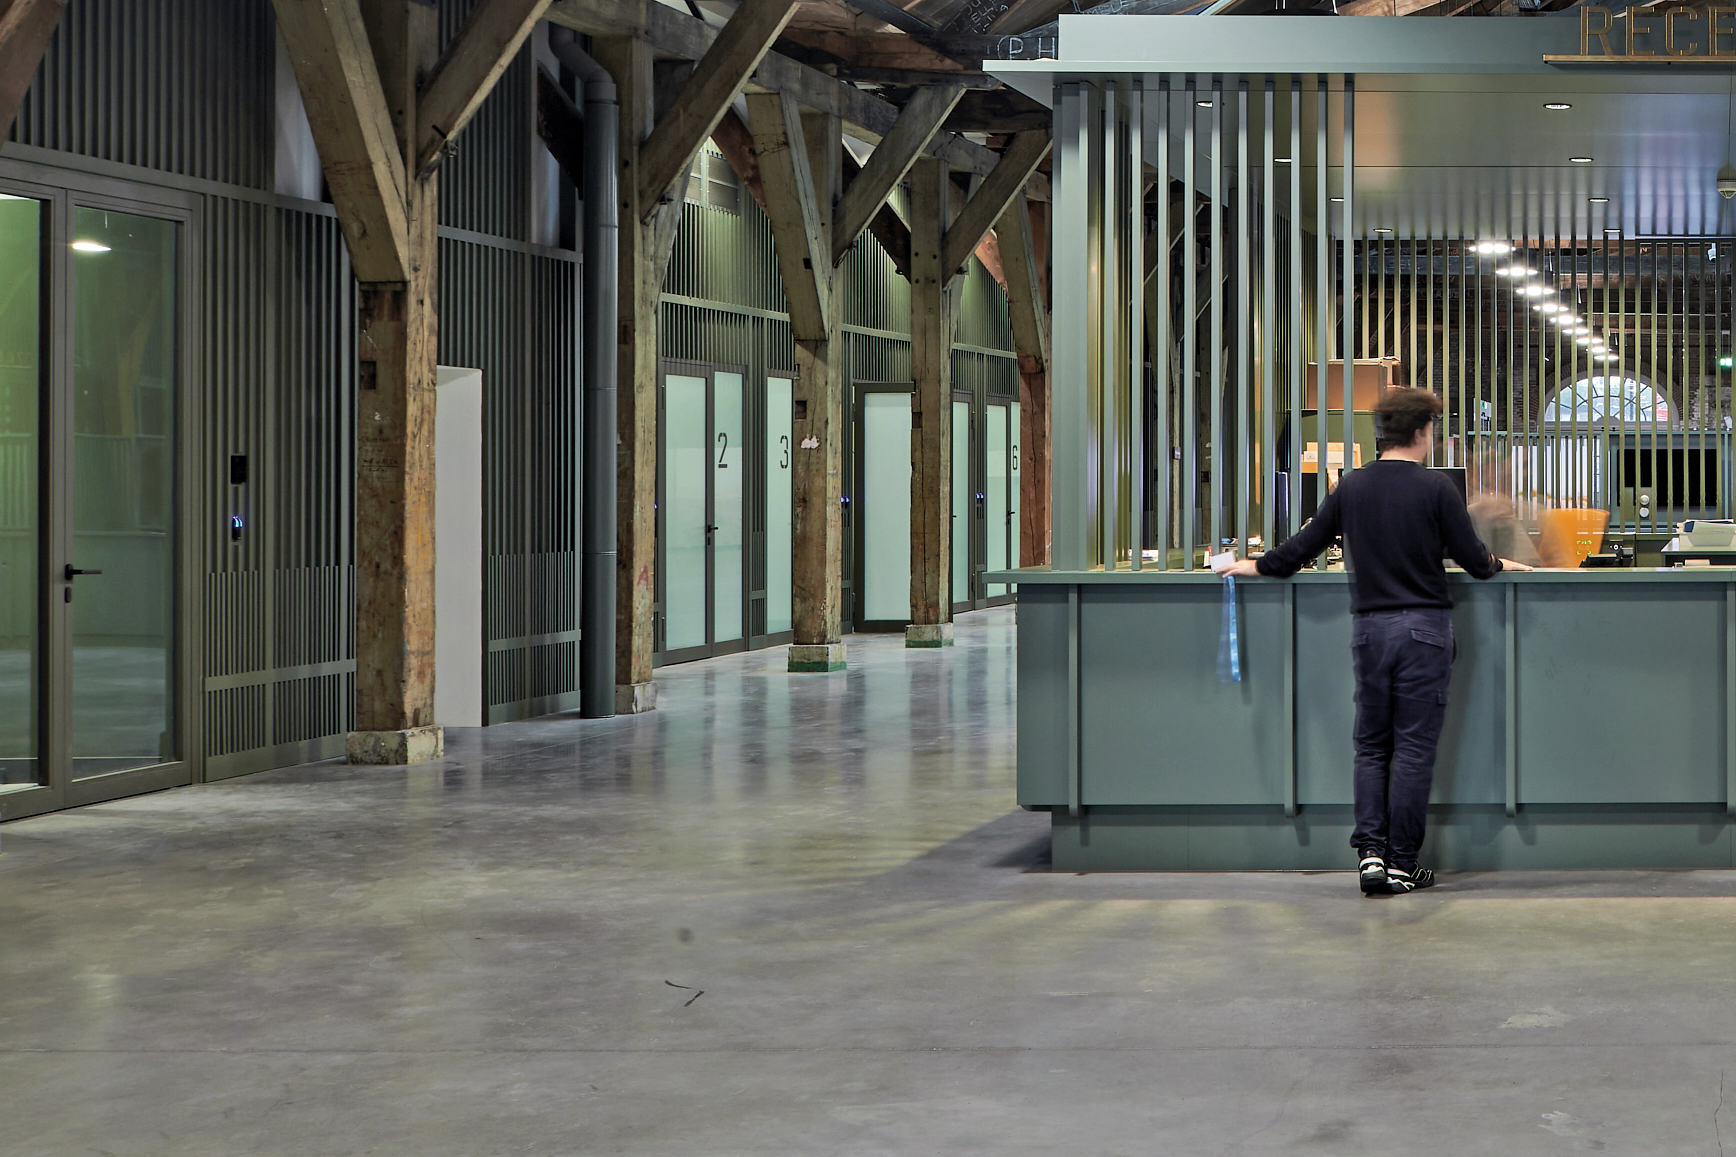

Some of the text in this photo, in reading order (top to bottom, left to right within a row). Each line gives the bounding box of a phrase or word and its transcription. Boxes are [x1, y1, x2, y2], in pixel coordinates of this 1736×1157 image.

[717, 432, 729, 469] 2
[779, 435, 790, 470] 3
[1012, 444, 1019, 471] 6
